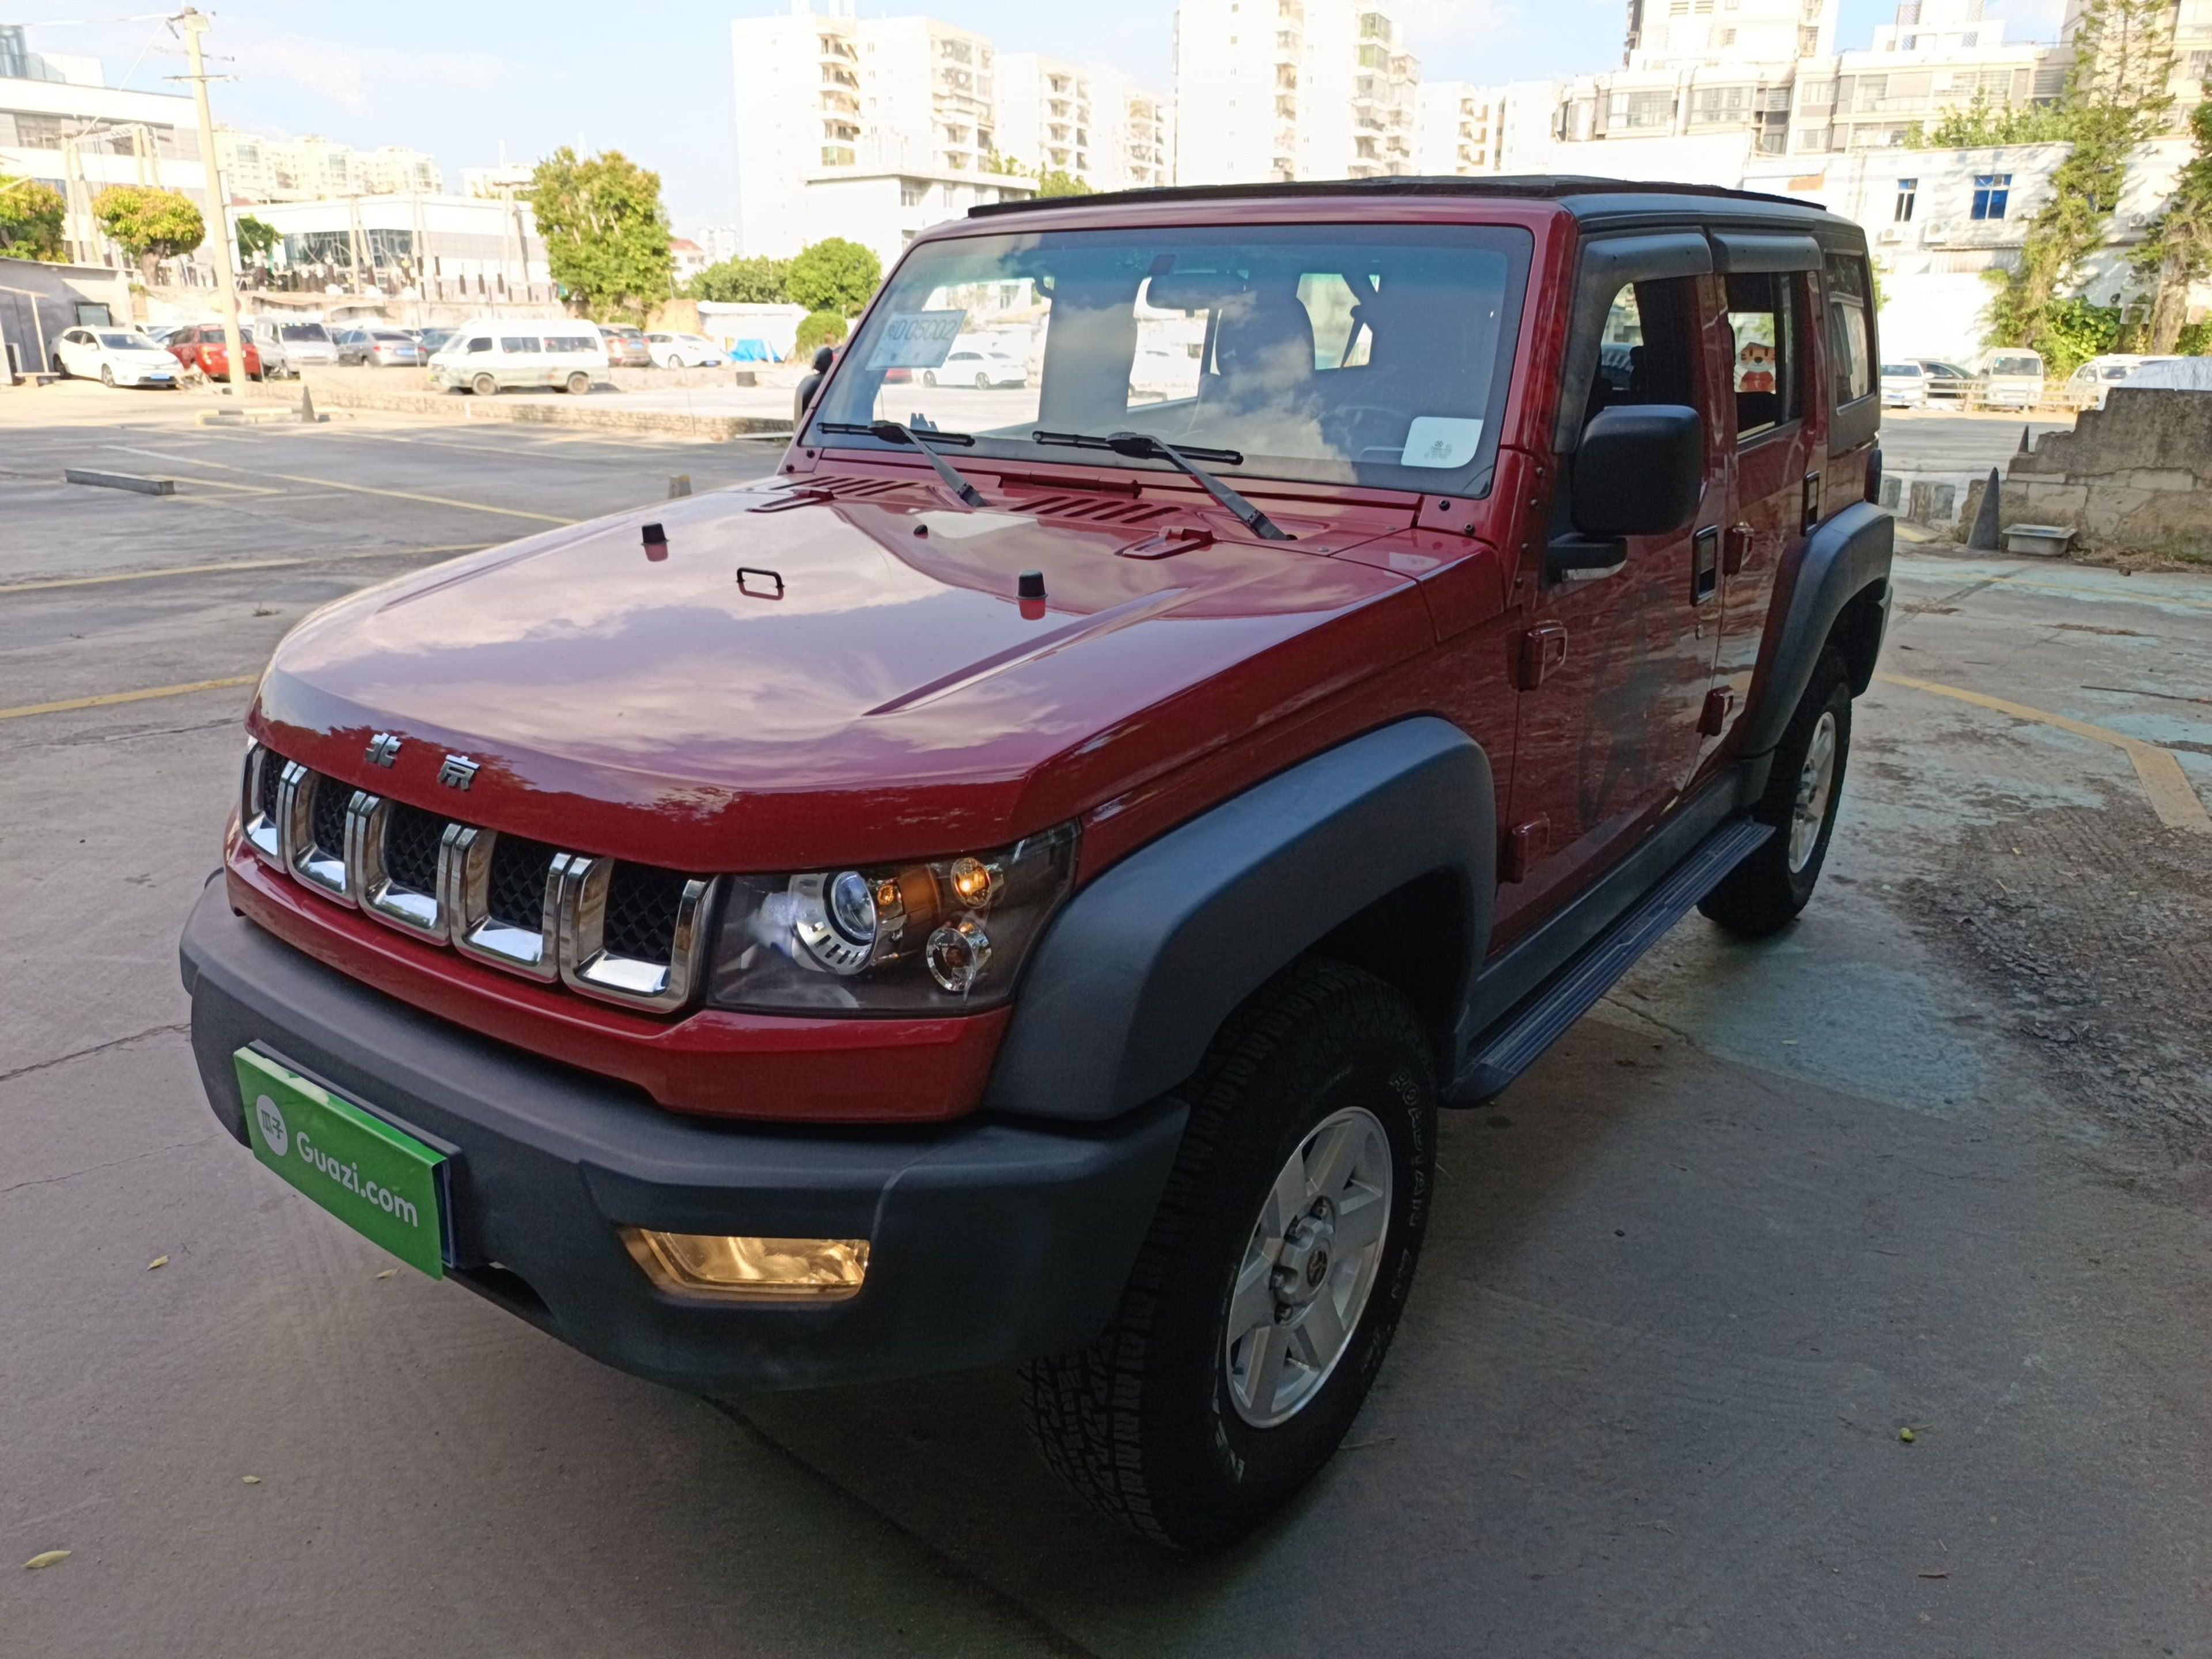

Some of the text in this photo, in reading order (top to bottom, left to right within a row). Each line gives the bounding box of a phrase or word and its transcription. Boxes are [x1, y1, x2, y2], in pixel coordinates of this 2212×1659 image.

[365, 732, 480, 790] 北京
[261, 1110, 285, 1140] 瓜子
[297, 1131, 418, 1228] Guazi.com
